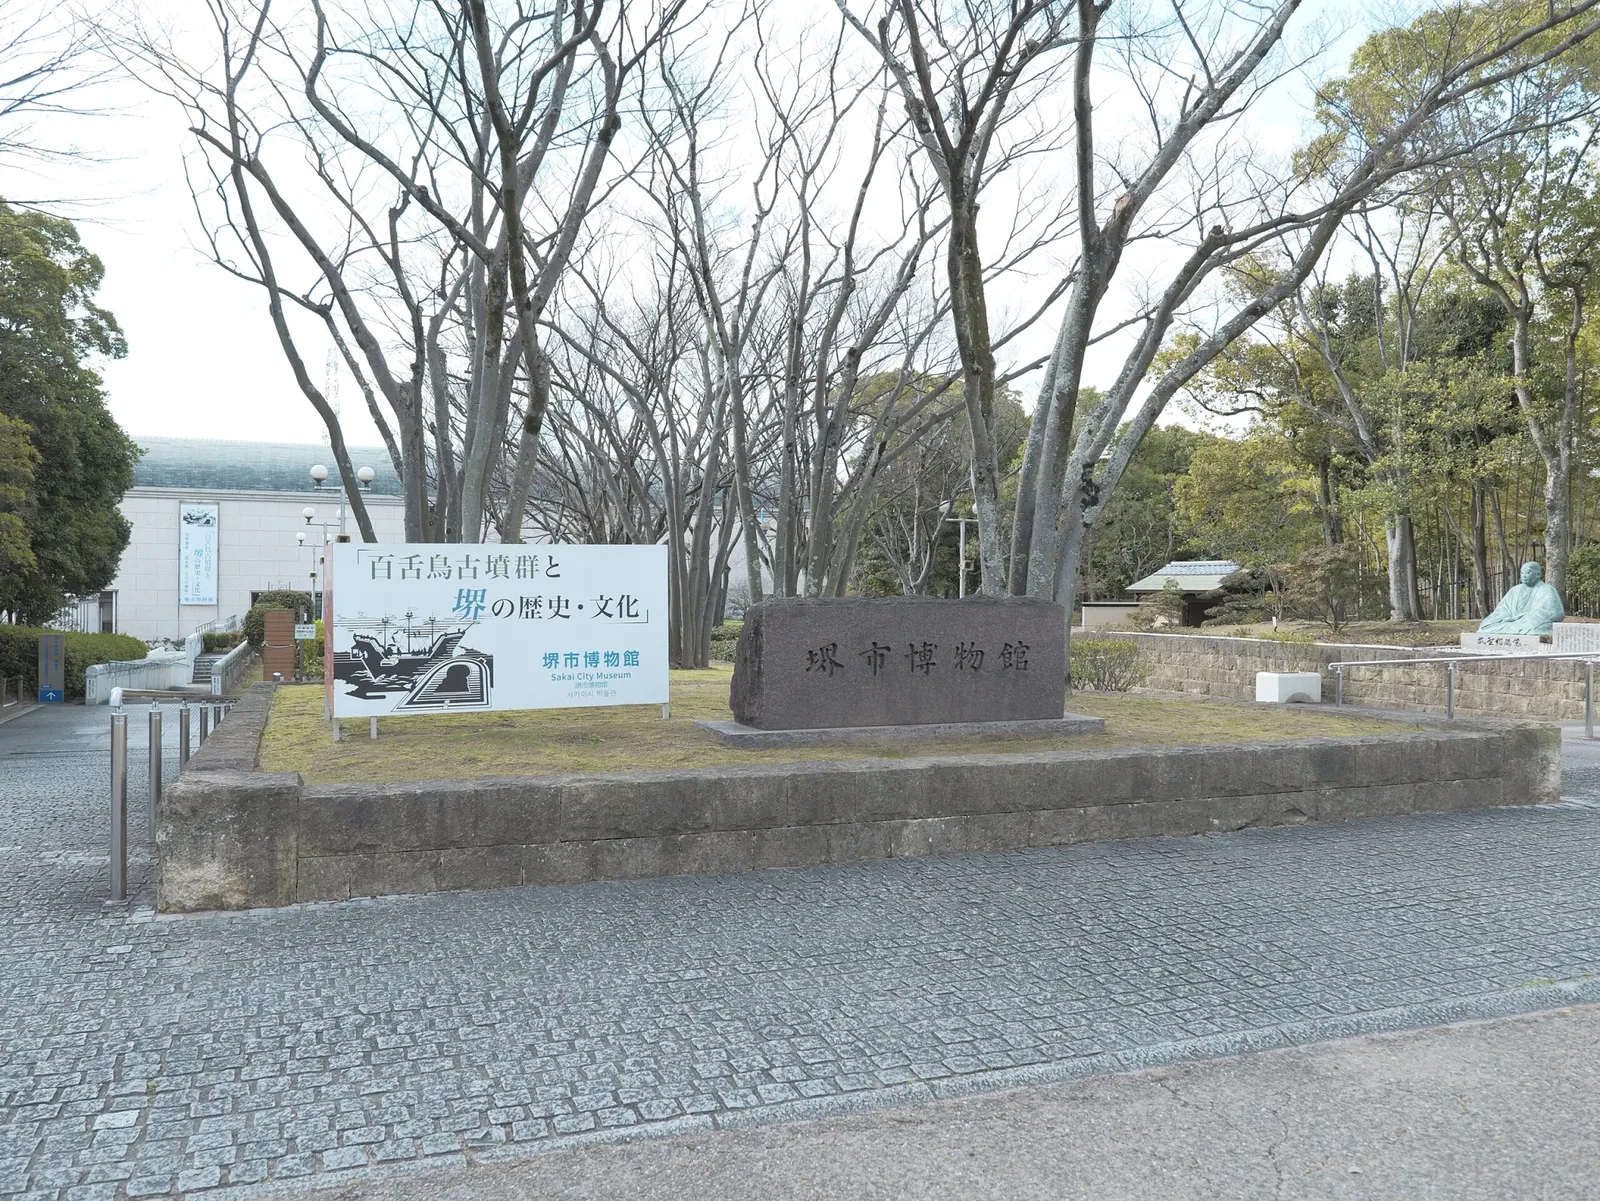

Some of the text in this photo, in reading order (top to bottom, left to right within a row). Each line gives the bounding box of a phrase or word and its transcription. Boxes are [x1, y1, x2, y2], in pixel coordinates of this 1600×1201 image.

[542, 650, 640, 669] 堺市博物館
[806, 640, 1031, 678] 堺市博物館
[551, 672, 631, 681] Sakai City Museum
